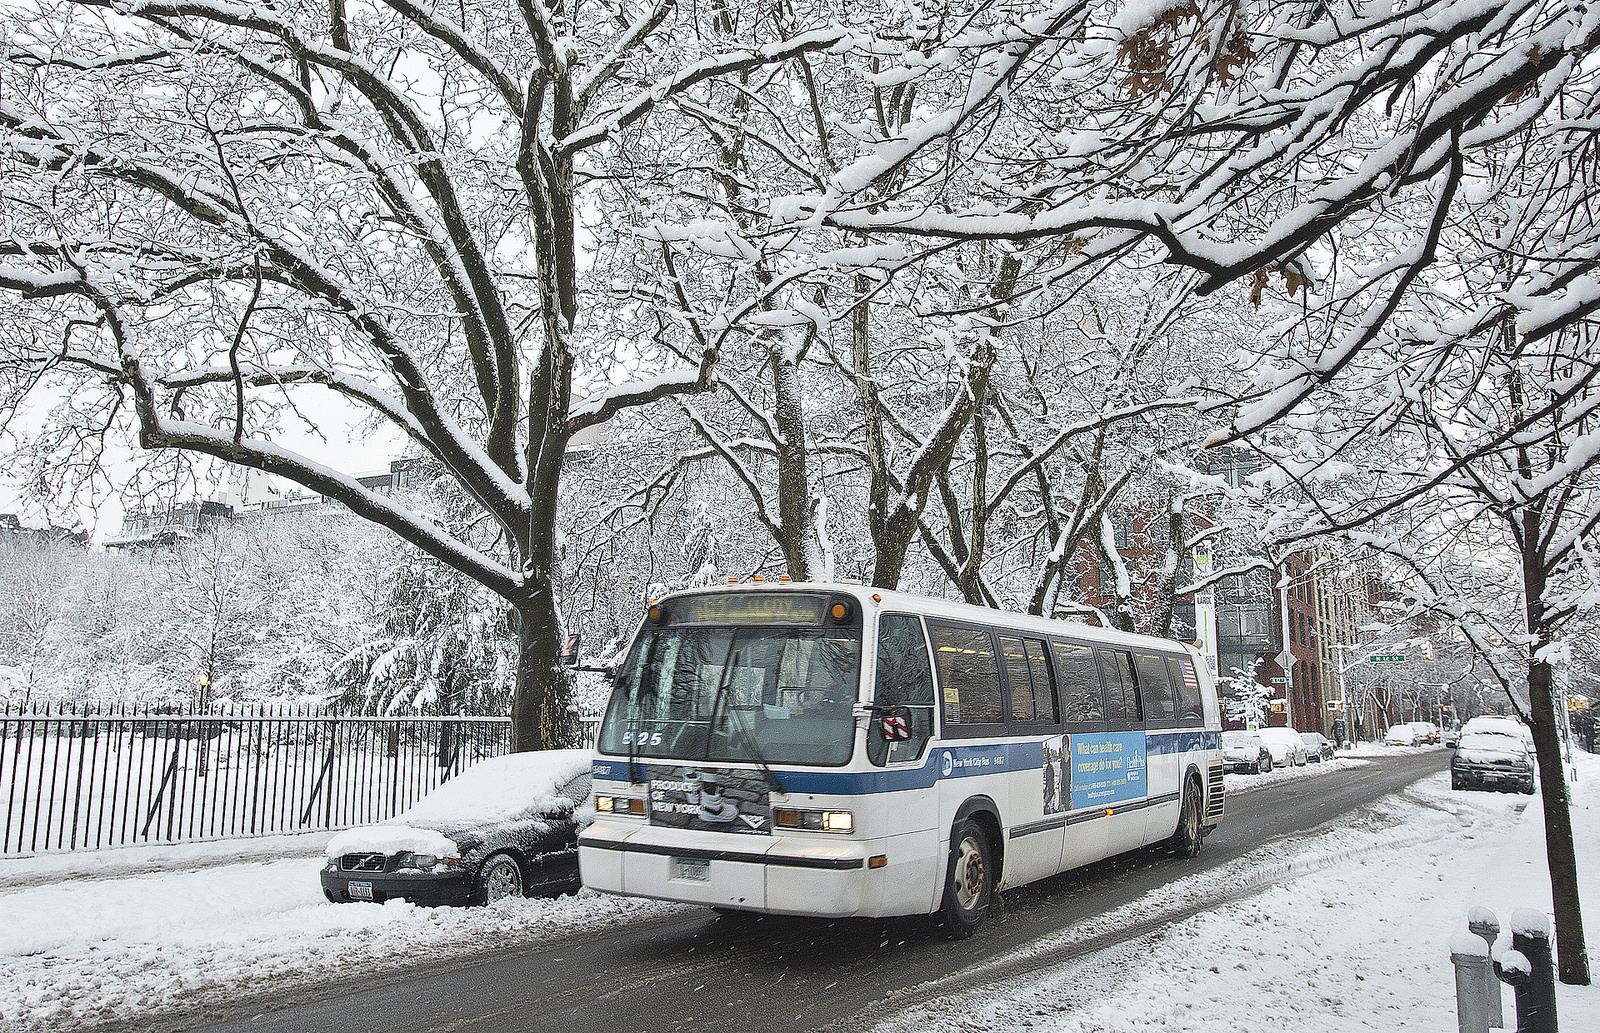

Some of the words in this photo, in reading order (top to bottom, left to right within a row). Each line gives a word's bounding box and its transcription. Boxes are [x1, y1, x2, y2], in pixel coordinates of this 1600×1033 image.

[1077, 742, 1090, 755] What
[1090, 744, 1099, 754] can
[1099, 741, 1113, 753] health
[1113, 743, 1122, 753] care
[953, 758, 963, 767] New
[963, 758, 972, 767] York
[973, 757, 981, 768] City
[1077, 761, 1099, 774] coverage
[1099, 759, 1106, 771] do
[1112, 756, 1123, 772] you?
[650, 780, 694, 792] PRODUCT
[651, 790, 665, 800] OF
[652, 801, 674, 813] NEW
[674, 803, 701, 815] YORK
